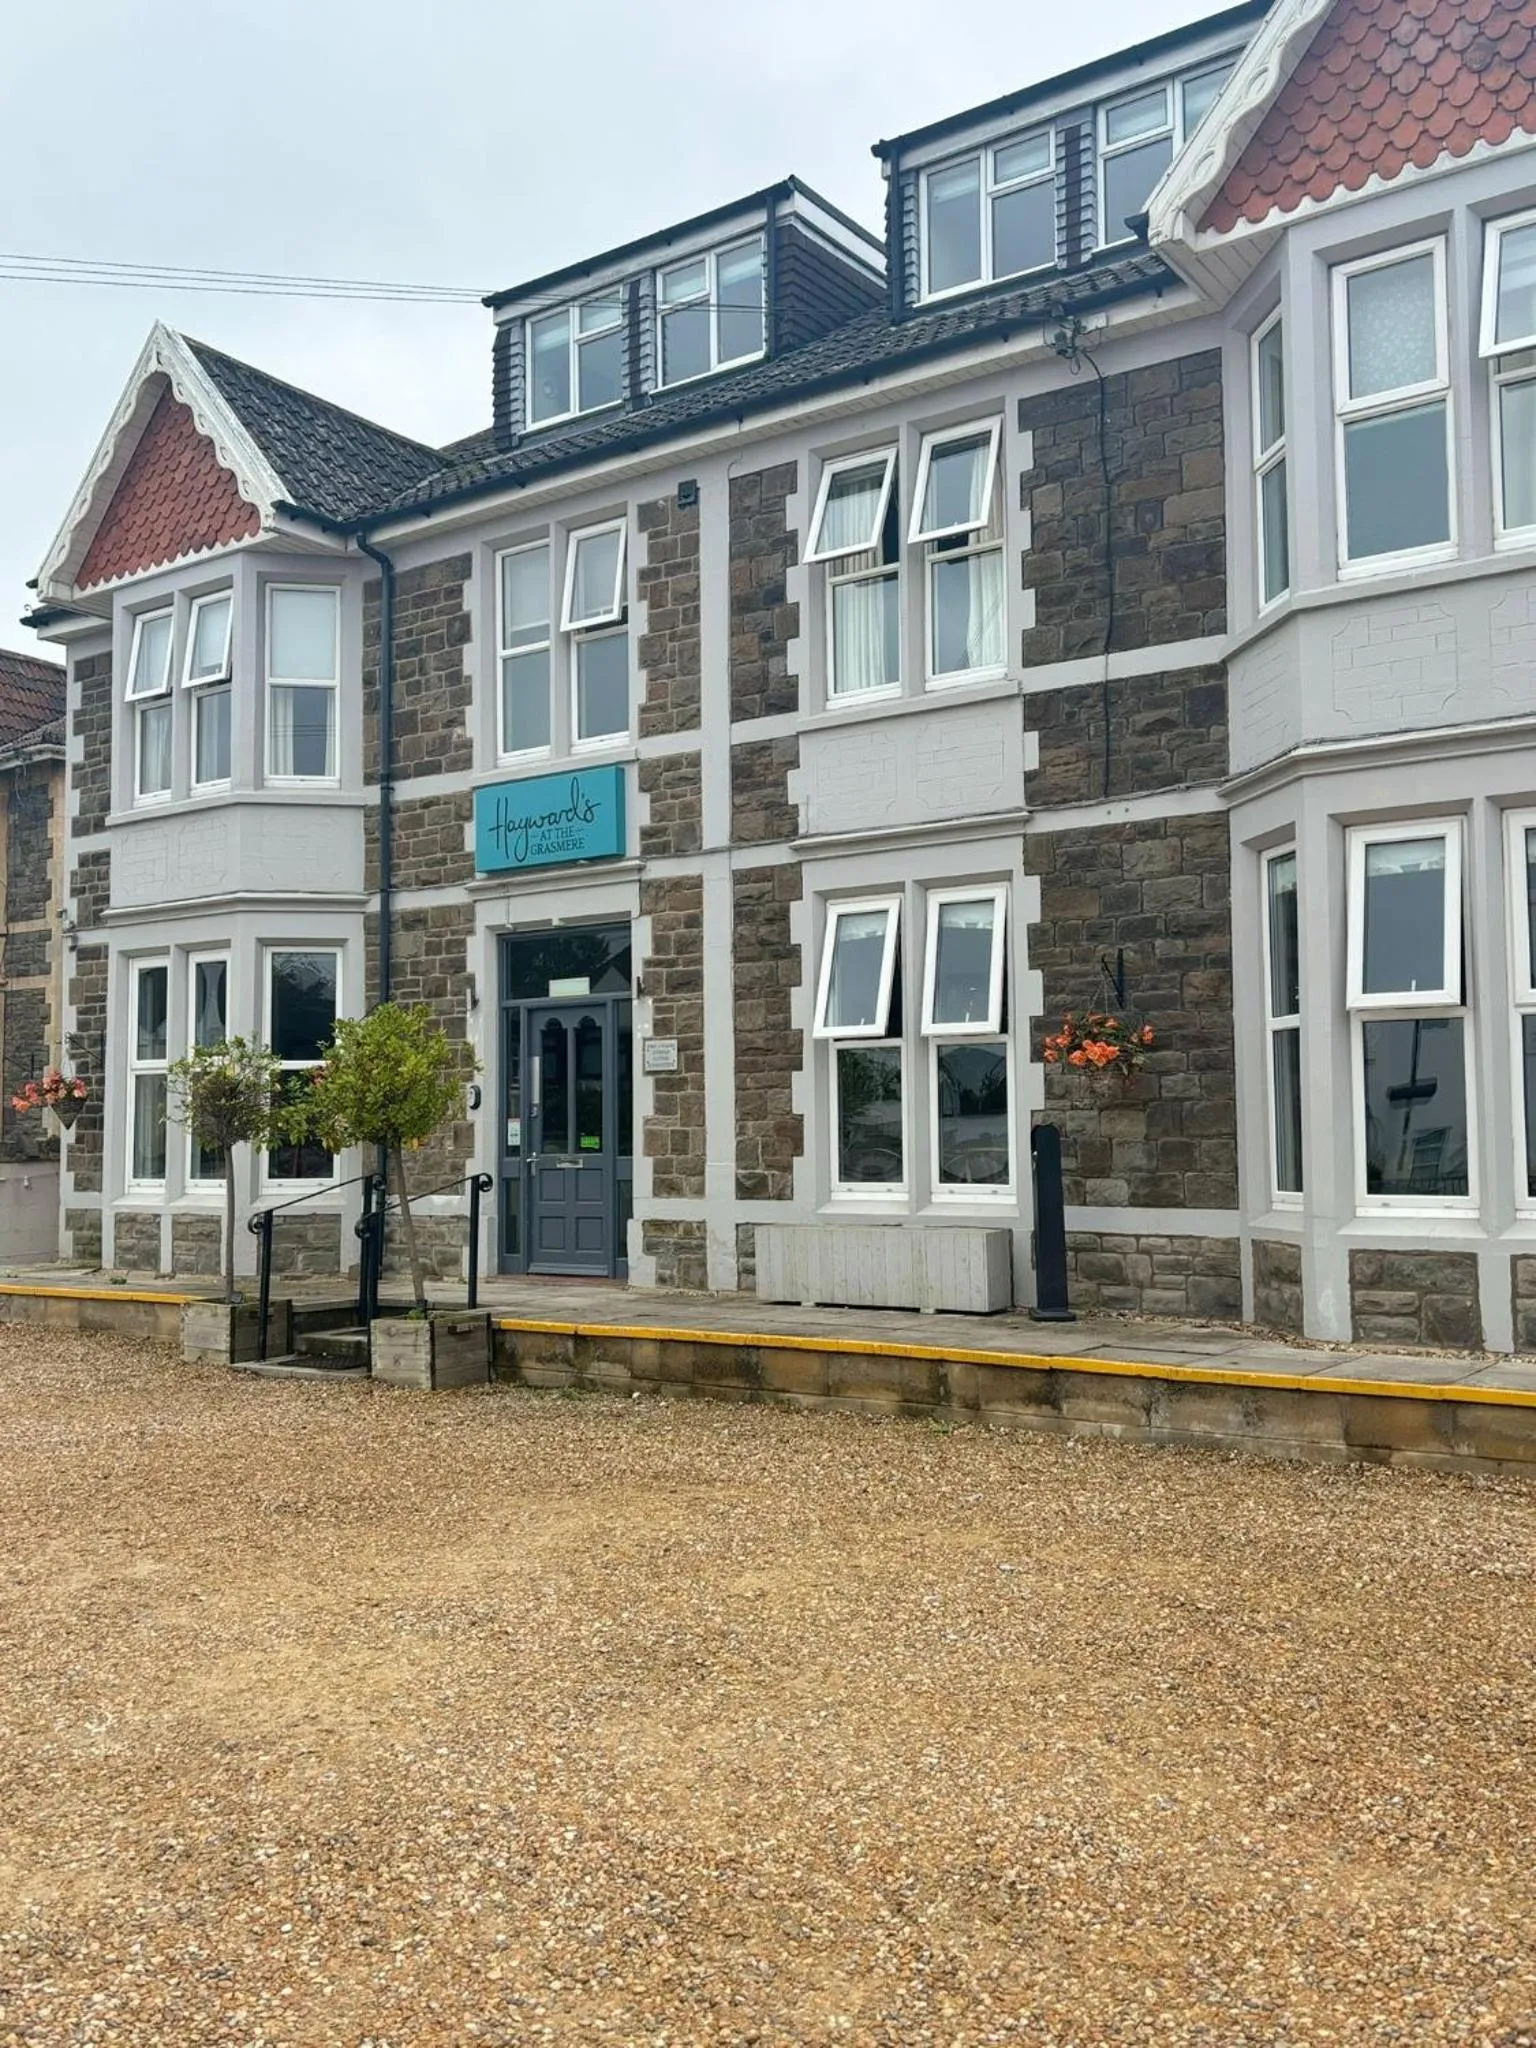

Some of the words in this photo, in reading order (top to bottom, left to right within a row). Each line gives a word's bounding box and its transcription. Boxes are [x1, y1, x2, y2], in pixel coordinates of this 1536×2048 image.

[488, 776, 601, 863] Hayward's
[539, 829, 552, 841] AT
[555, 826, 575, 839] THE
[530, 837, 585, 856] GRASMERE
